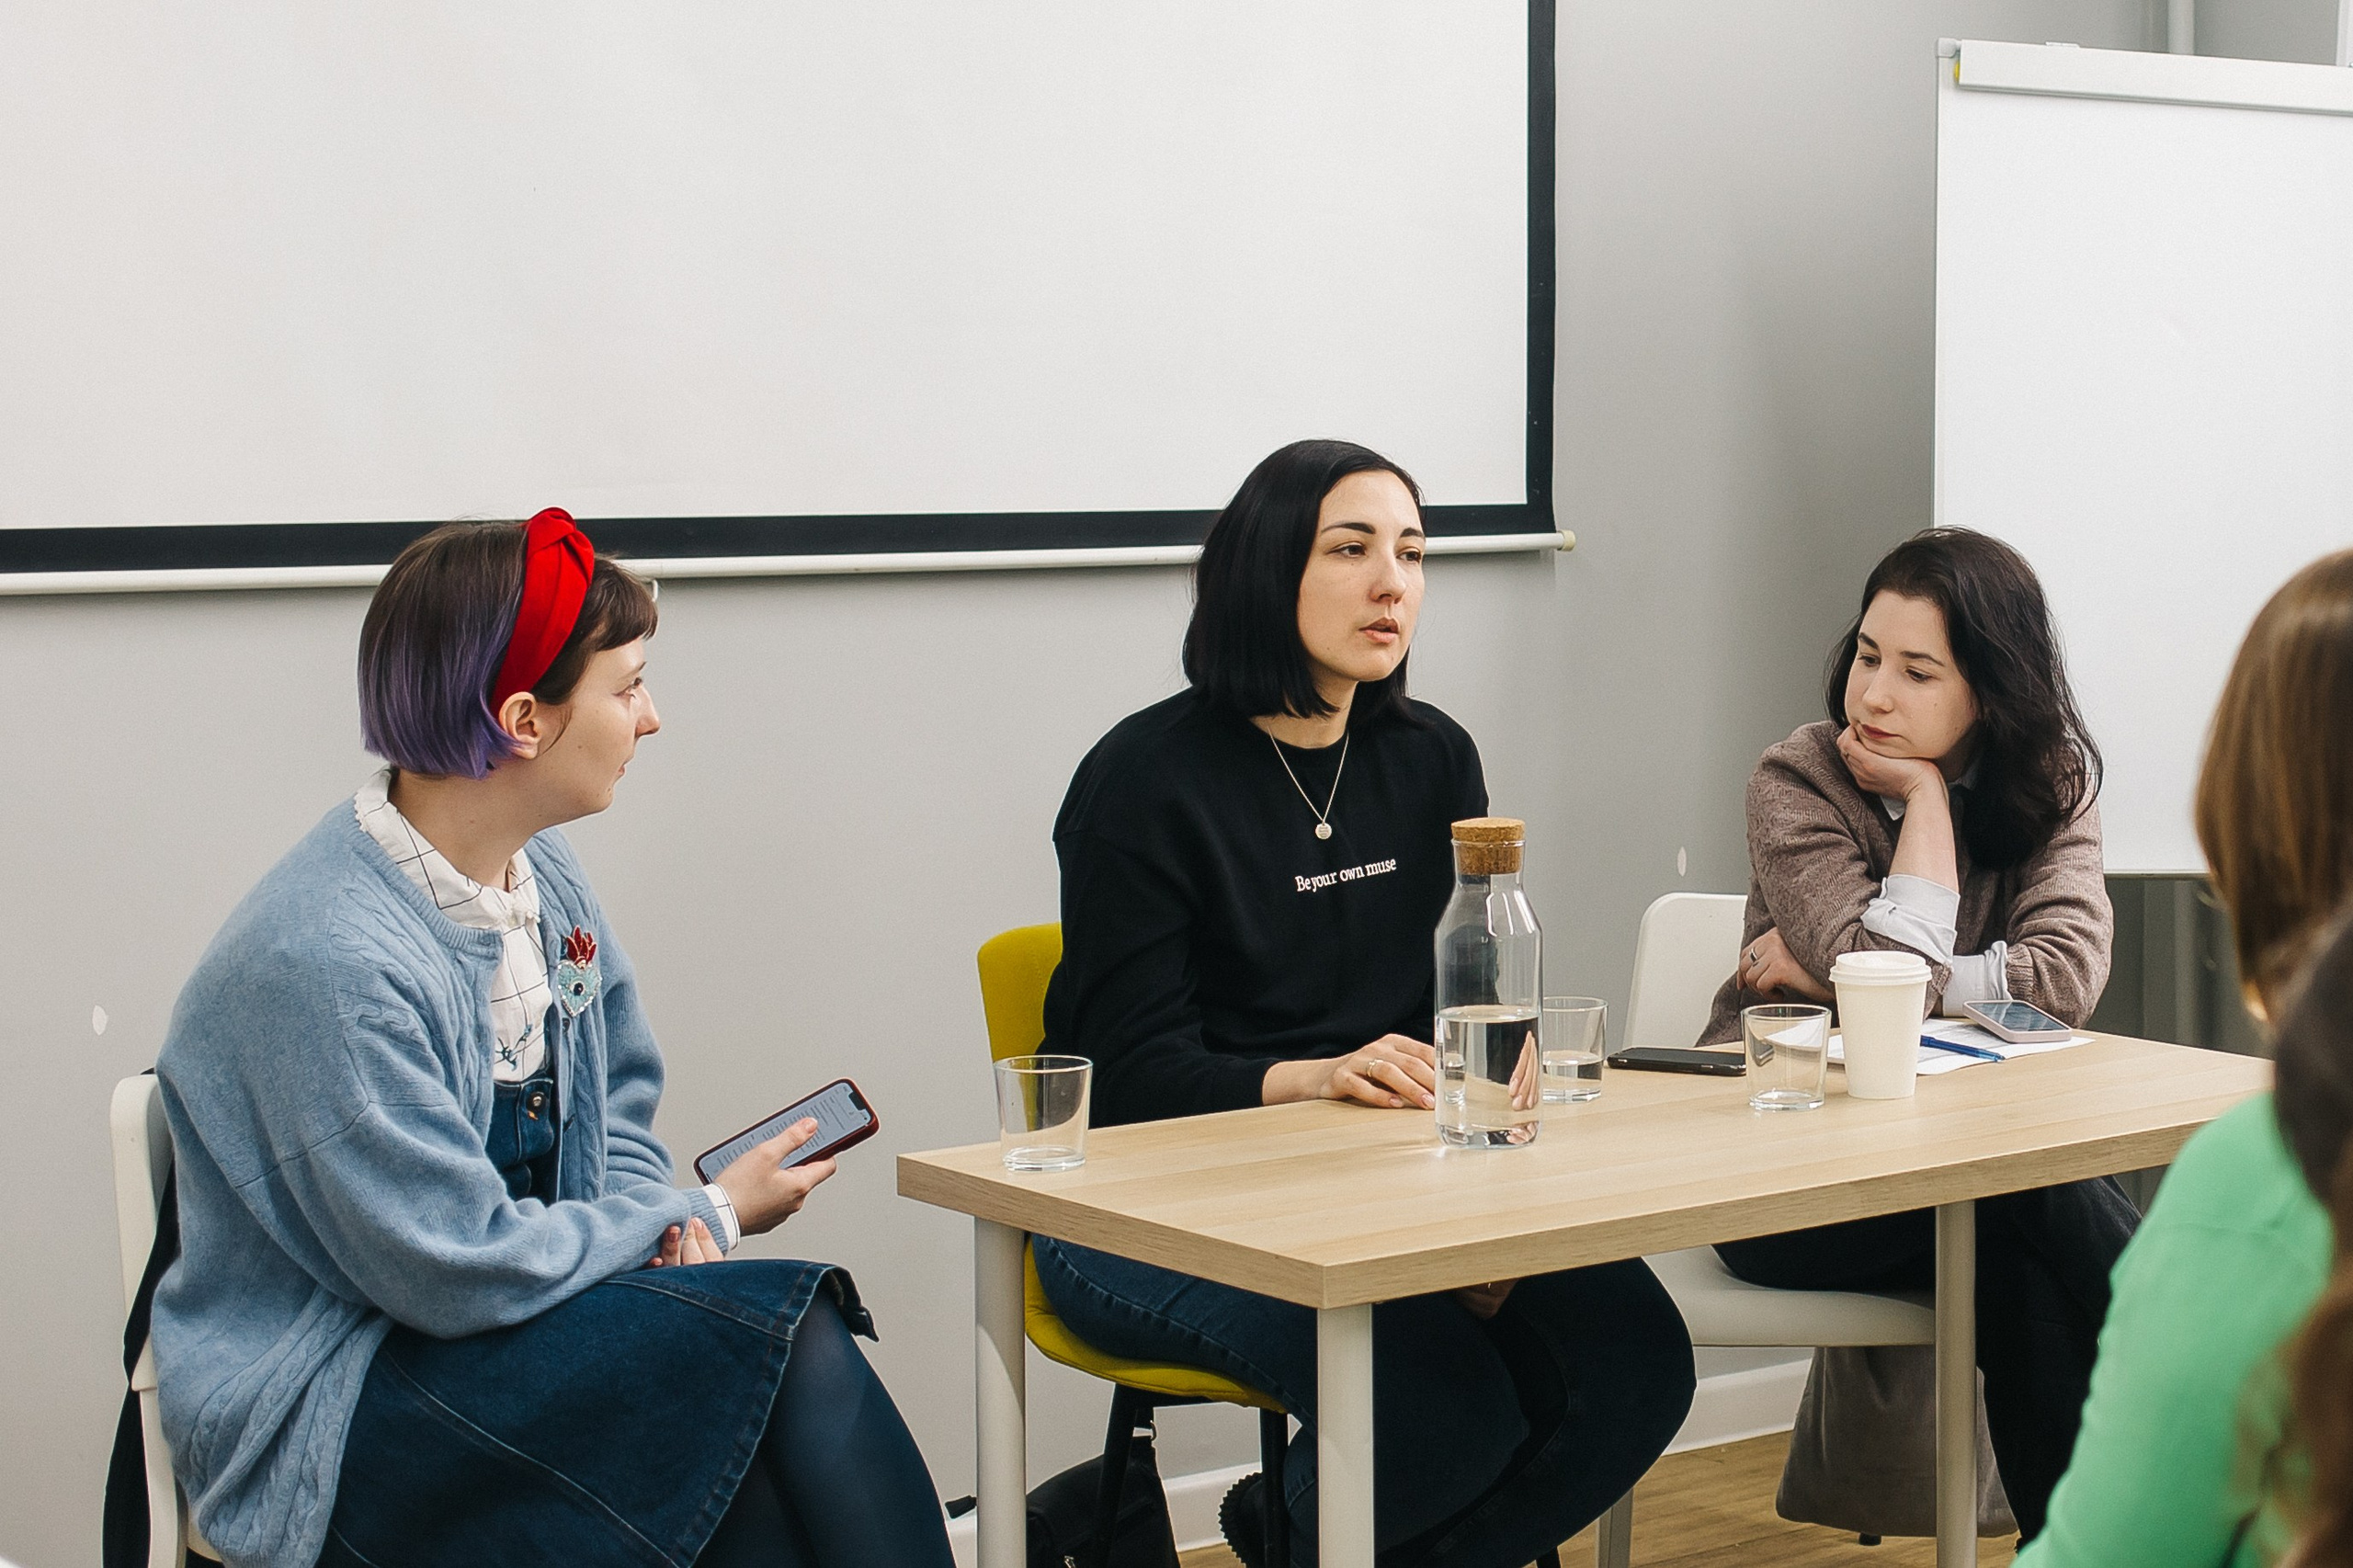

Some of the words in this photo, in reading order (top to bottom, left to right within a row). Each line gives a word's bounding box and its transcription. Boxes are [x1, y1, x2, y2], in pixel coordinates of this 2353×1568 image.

[1295, 875, 1312, 892] Be
[1311, 871, 1337, 893] your
[1339, 866, 1365, 882] own
[1365, 858, 1397, 877] muse
